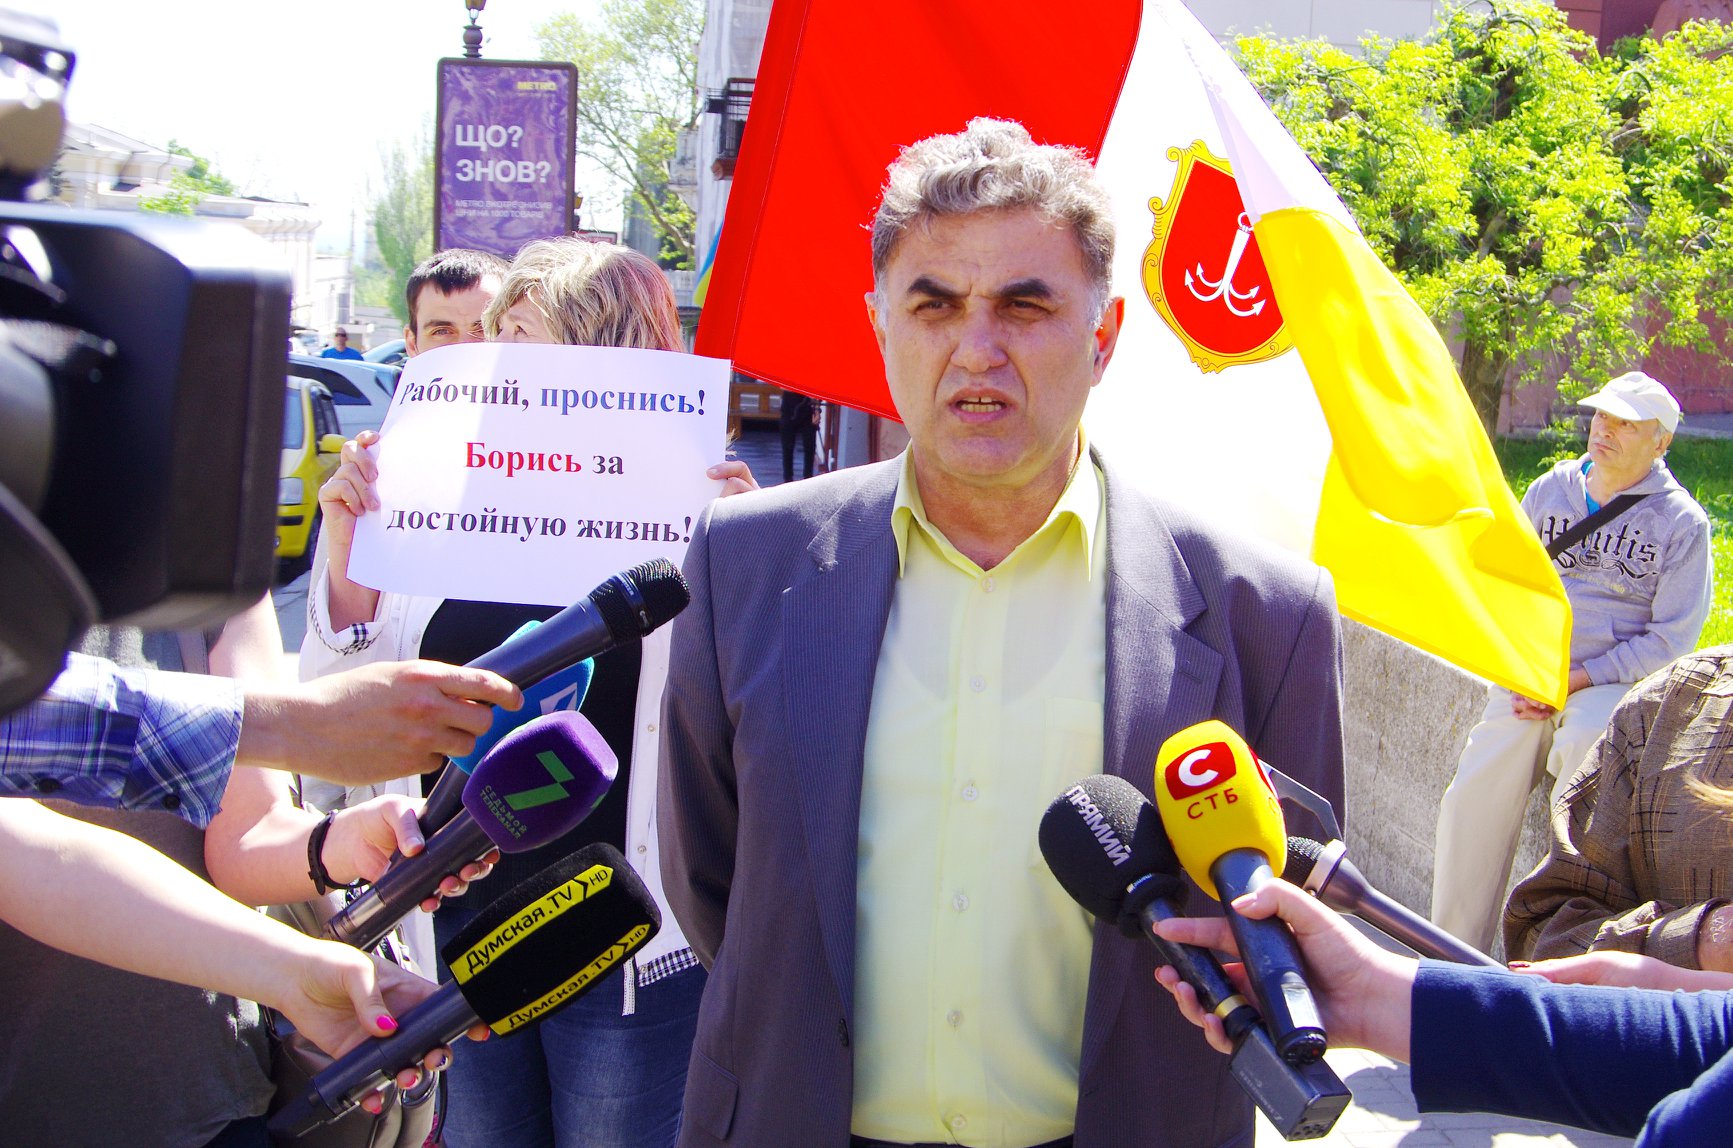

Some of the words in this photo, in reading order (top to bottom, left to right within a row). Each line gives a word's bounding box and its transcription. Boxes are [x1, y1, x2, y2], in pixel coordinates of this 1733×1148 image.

[455, 124, 523, 152] ЩО?
[455, 159, 551, 183] ЗНОВ?
[540, 386, 705, 416] проснись!
[465, 442, 582, 477] Борись
[592, 454, 624, 475] за
[386, 507, 567, 542] достойную
[576, 516, 692, 543] жизнь!
[1187, 788, 1239, 820] СТБ
[1065, 784, 1133, 867] ПРЯМИЙ
[589, 868, 609, 886] HD
[629, 927, 646, 943] HD
